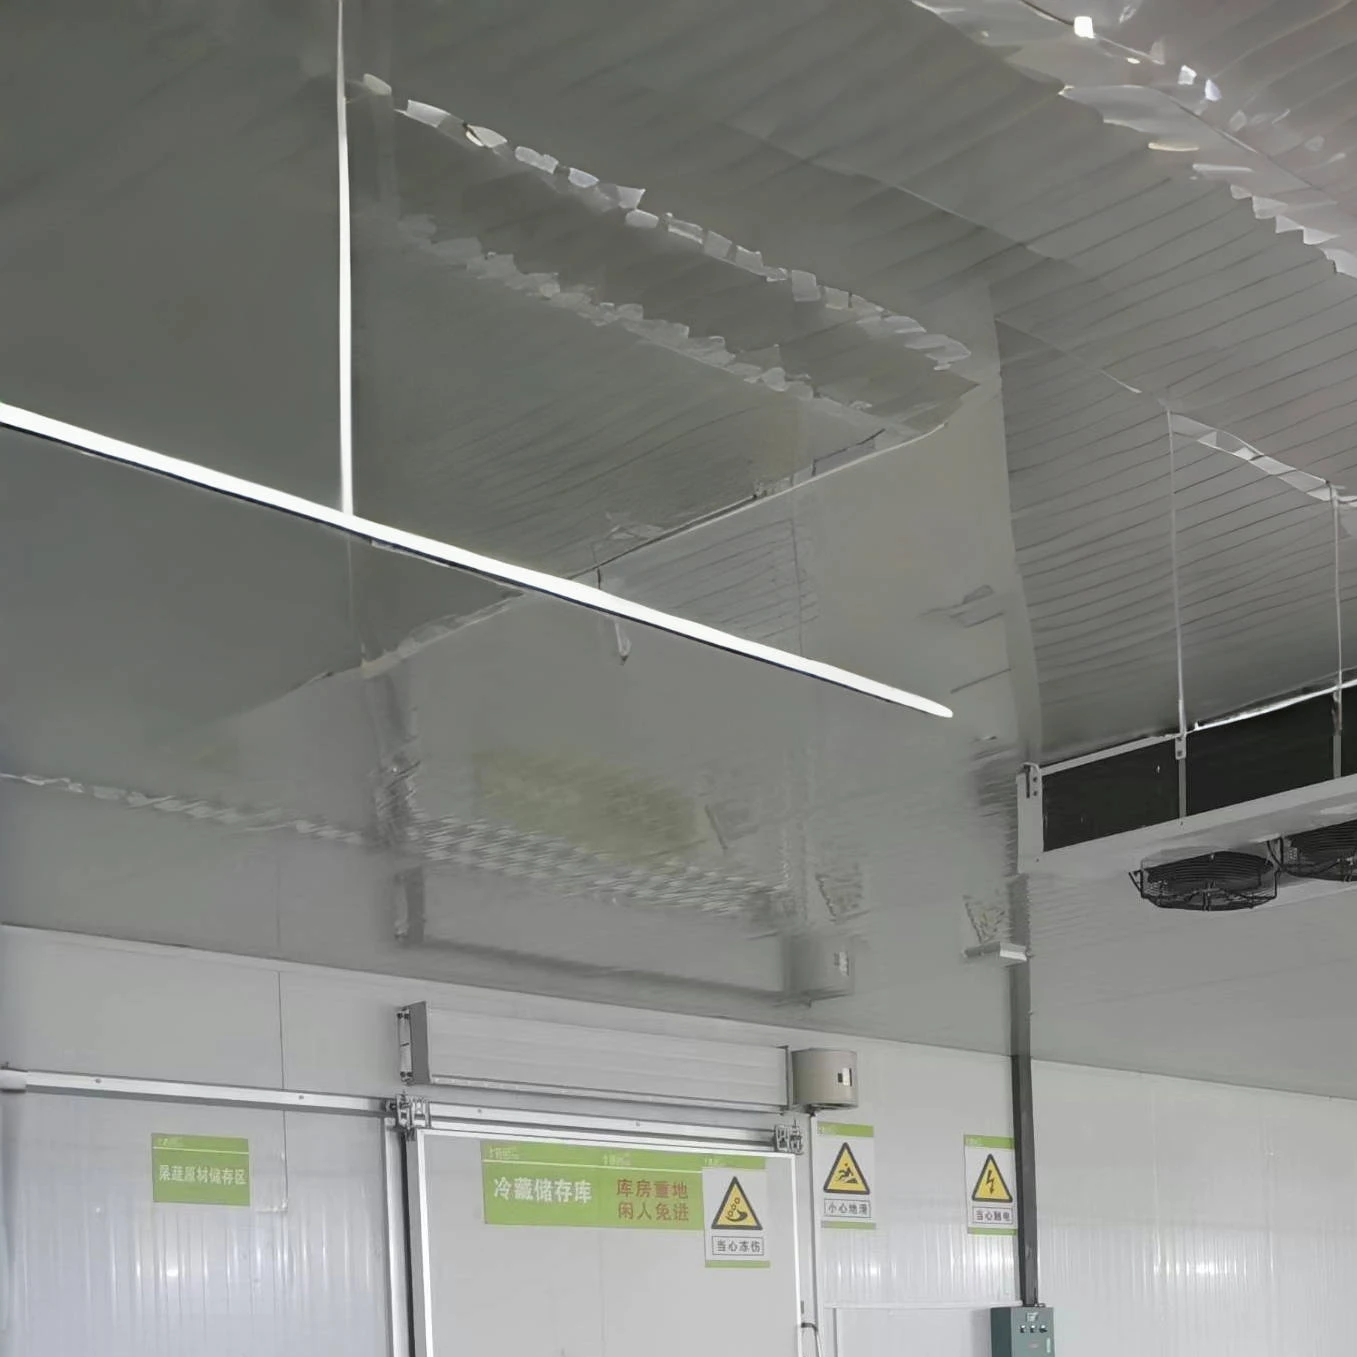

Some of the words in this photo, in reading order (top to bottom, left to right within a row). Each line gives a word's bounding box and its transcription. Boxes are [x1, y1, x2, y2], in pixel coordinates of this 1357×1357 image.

[493, 1176, 593, 1203] 冷藏储存库
[616, 1178, 689, 1200] 库房重地
[617, 1202, 690, 1222] 闲人免进
[828, 1202, 868, 1215] 小心地滑
[717, 1240, 761, 1253] 当心冻伤
